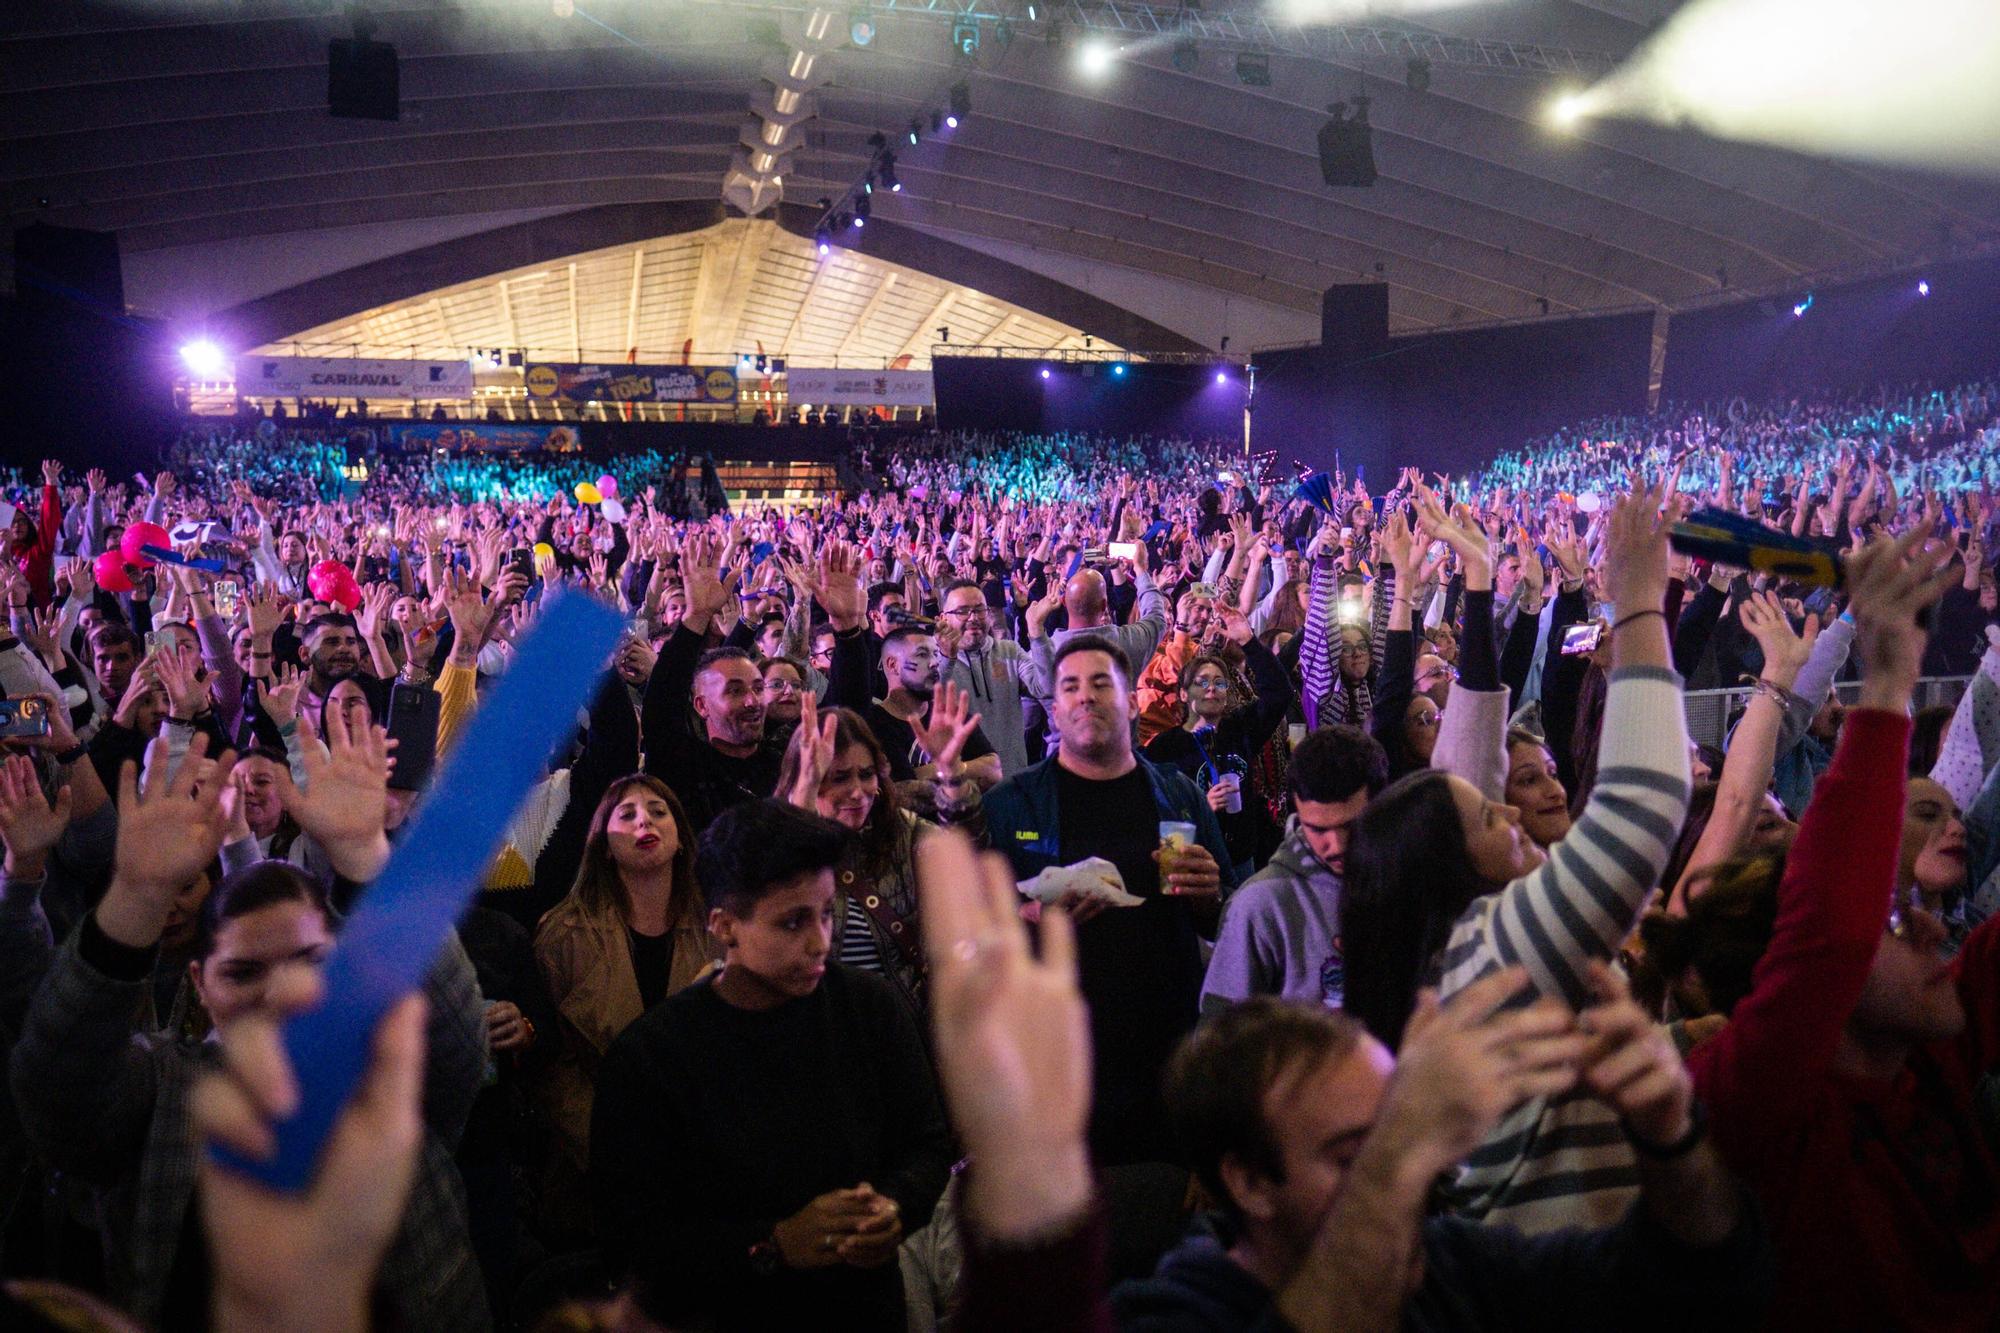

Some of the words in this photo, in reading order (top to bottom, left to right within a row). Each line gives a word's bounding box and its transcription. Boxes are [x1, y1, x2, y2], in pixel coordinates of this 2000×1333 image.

[310, 373, 401, 386] CARNAVAL
[655, 374, 696, 388] MUCHO
[608, 375, 653, 400] TODO
